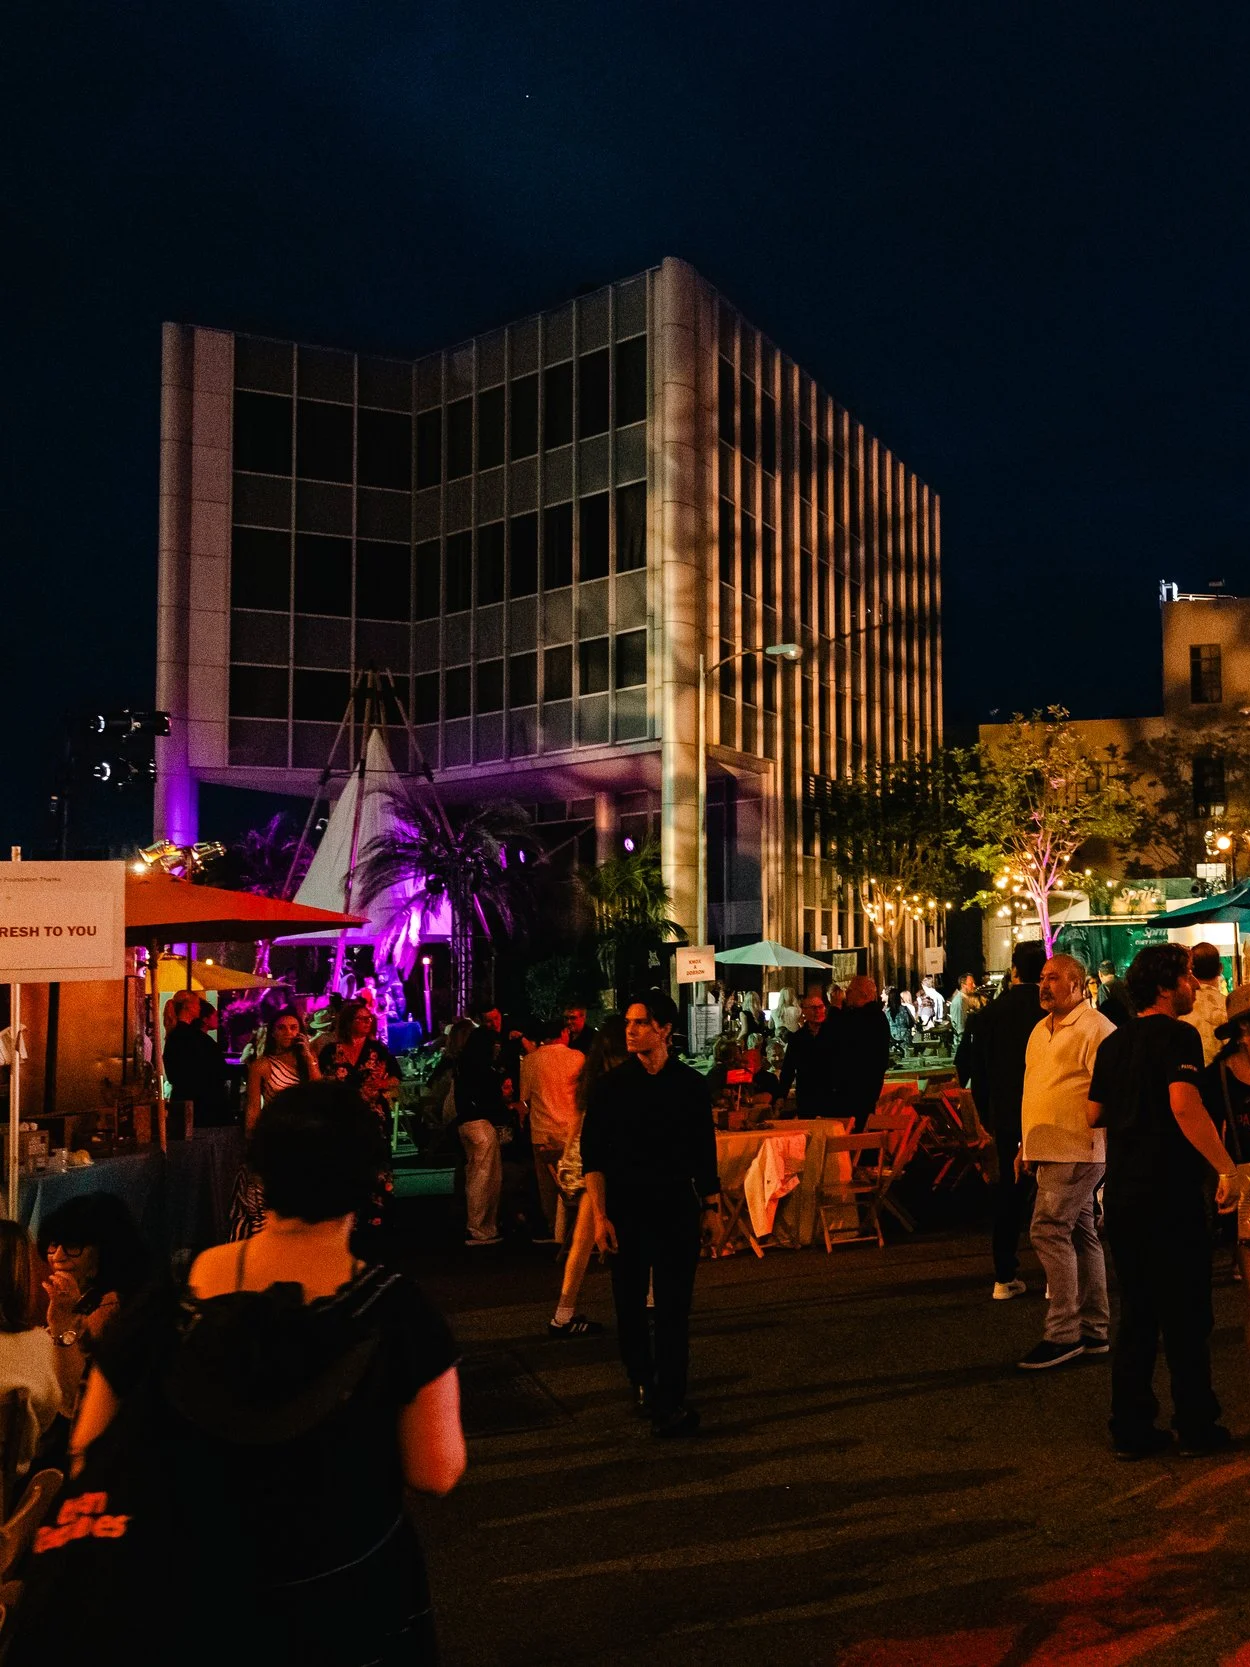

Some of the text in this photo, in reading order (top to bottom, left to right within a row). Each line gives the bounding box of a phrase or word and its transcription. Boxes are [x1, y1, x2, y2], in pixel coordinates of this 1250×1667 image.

[1121, 886, 1161, 904] Sprite
[44, 926, 63, 937] TO
[67, 925, 97, 936] YOU
